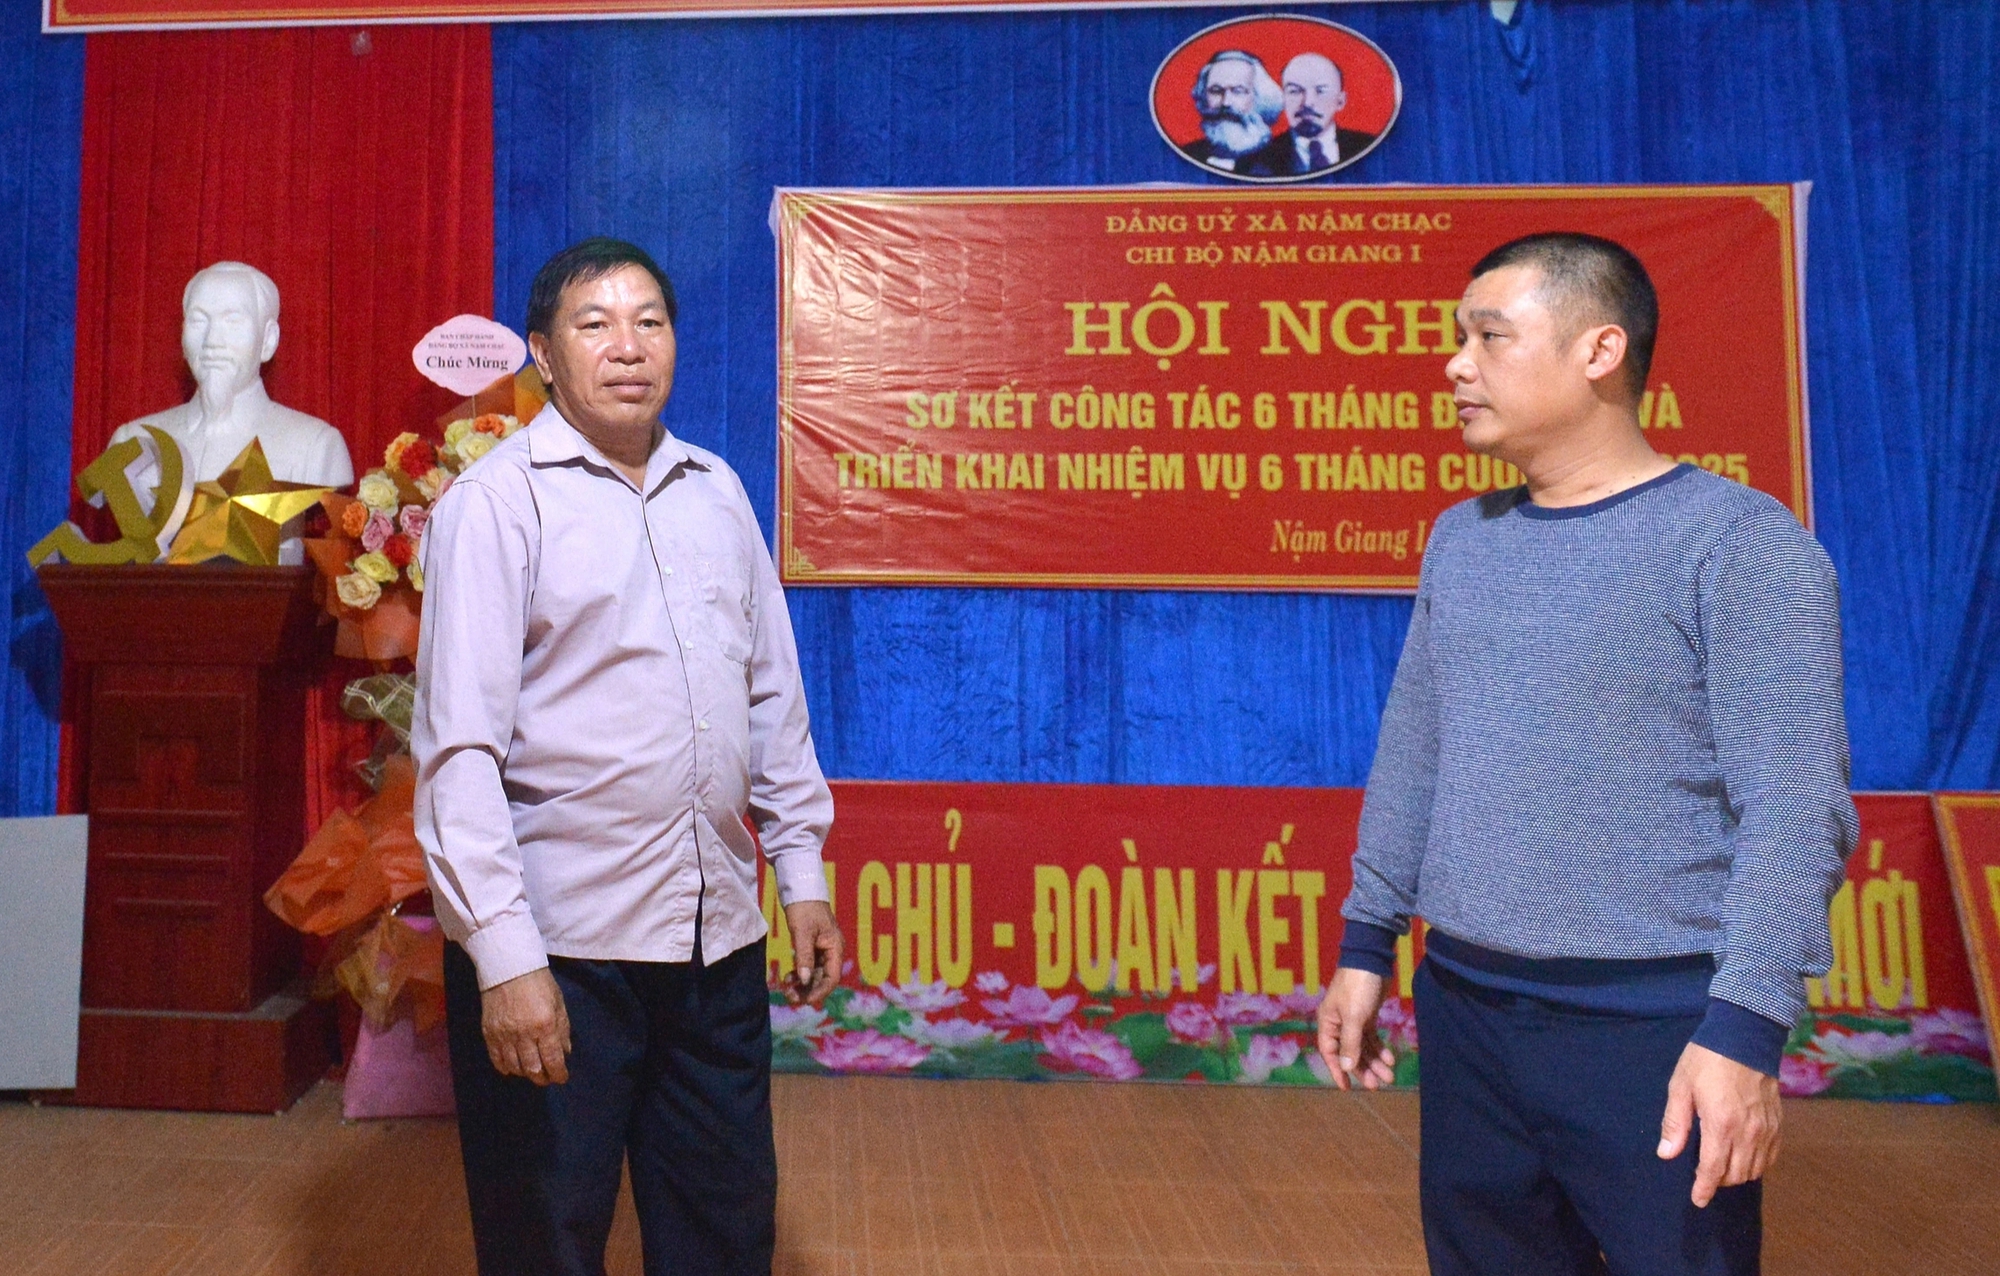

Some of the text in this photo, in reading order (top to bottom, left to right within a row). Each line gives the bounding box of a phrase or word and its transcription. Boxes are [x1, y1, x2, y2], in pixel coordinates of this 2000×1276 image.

[1106, 208, 1188, 233] ĐẢNG
[1197, 207, 1237, 232] UỶ
[1297, 209, 1365, 235] NẬM
[1371, 212, 1452, 235] CHẠC
[1126, 240, 1422, 268] CHI BỘ NẬM GIANG I
[1064, 282, 1461, 371] HỘI NGH
[426, 355, 508, 370] Chúc Mừng
[906, 391, 958, 430] SƠ
[968, 379, 1038, 430] KẾT
[1049, 386, 1156, 430] CÔNG
[1167, 384, 1242, 430] TÁC
[1253, 392, 1278, 430] 6
[1288, 383, 1419, 430] THÁNG
[834, 439, 943, 490] TRIỂN
[956, 453, 1045, 490] KHAI
[1058, 446, 1185, 498] NHIỆM
[1197, 453, 1247, 499] VỤ
[1259, 454, 1284, 491] 6
[1294, 446, 1427, 492] THÁNG
[1270, 519, 1327, 562] Nậm
[1334, 519, 1410, 561] Giang
[857, 808, 972, 987] CHỦ
[993, 923, 1014, 947] -
[1033, 839, 1198, 993] ĐOÀN
[1216, 824, 1326, 995] KẾT
